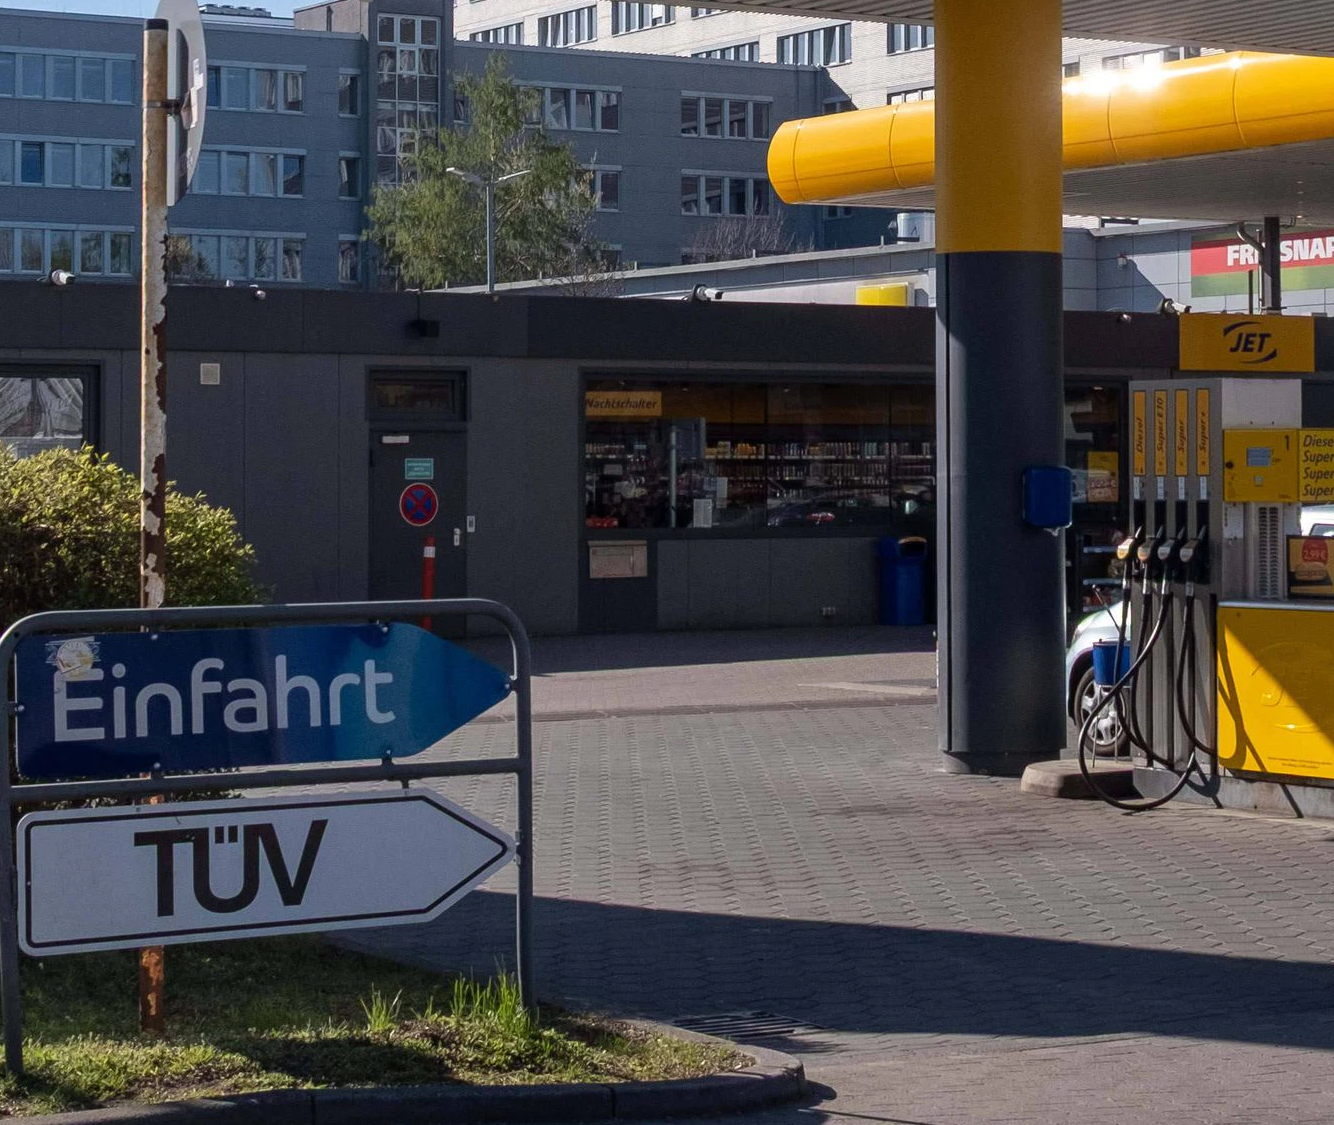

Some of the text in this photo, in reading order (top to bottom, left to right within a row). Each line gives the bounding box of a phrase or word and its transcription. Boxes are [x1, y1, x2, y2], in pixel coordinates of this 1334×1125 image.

[1229, 332, 1272, 353] JET
[586, 396, 658, 410] Nachtschalter
[1156, 421, 1165, 453] Super
[1178, 420, 1186, 452] Super
[1284, 434, 1290, 451] 1
[1303, 451, 1334, 467] Super
[53, 653, 397, 743] Einfahrt
[134, 819, 329, 917] TÜV
